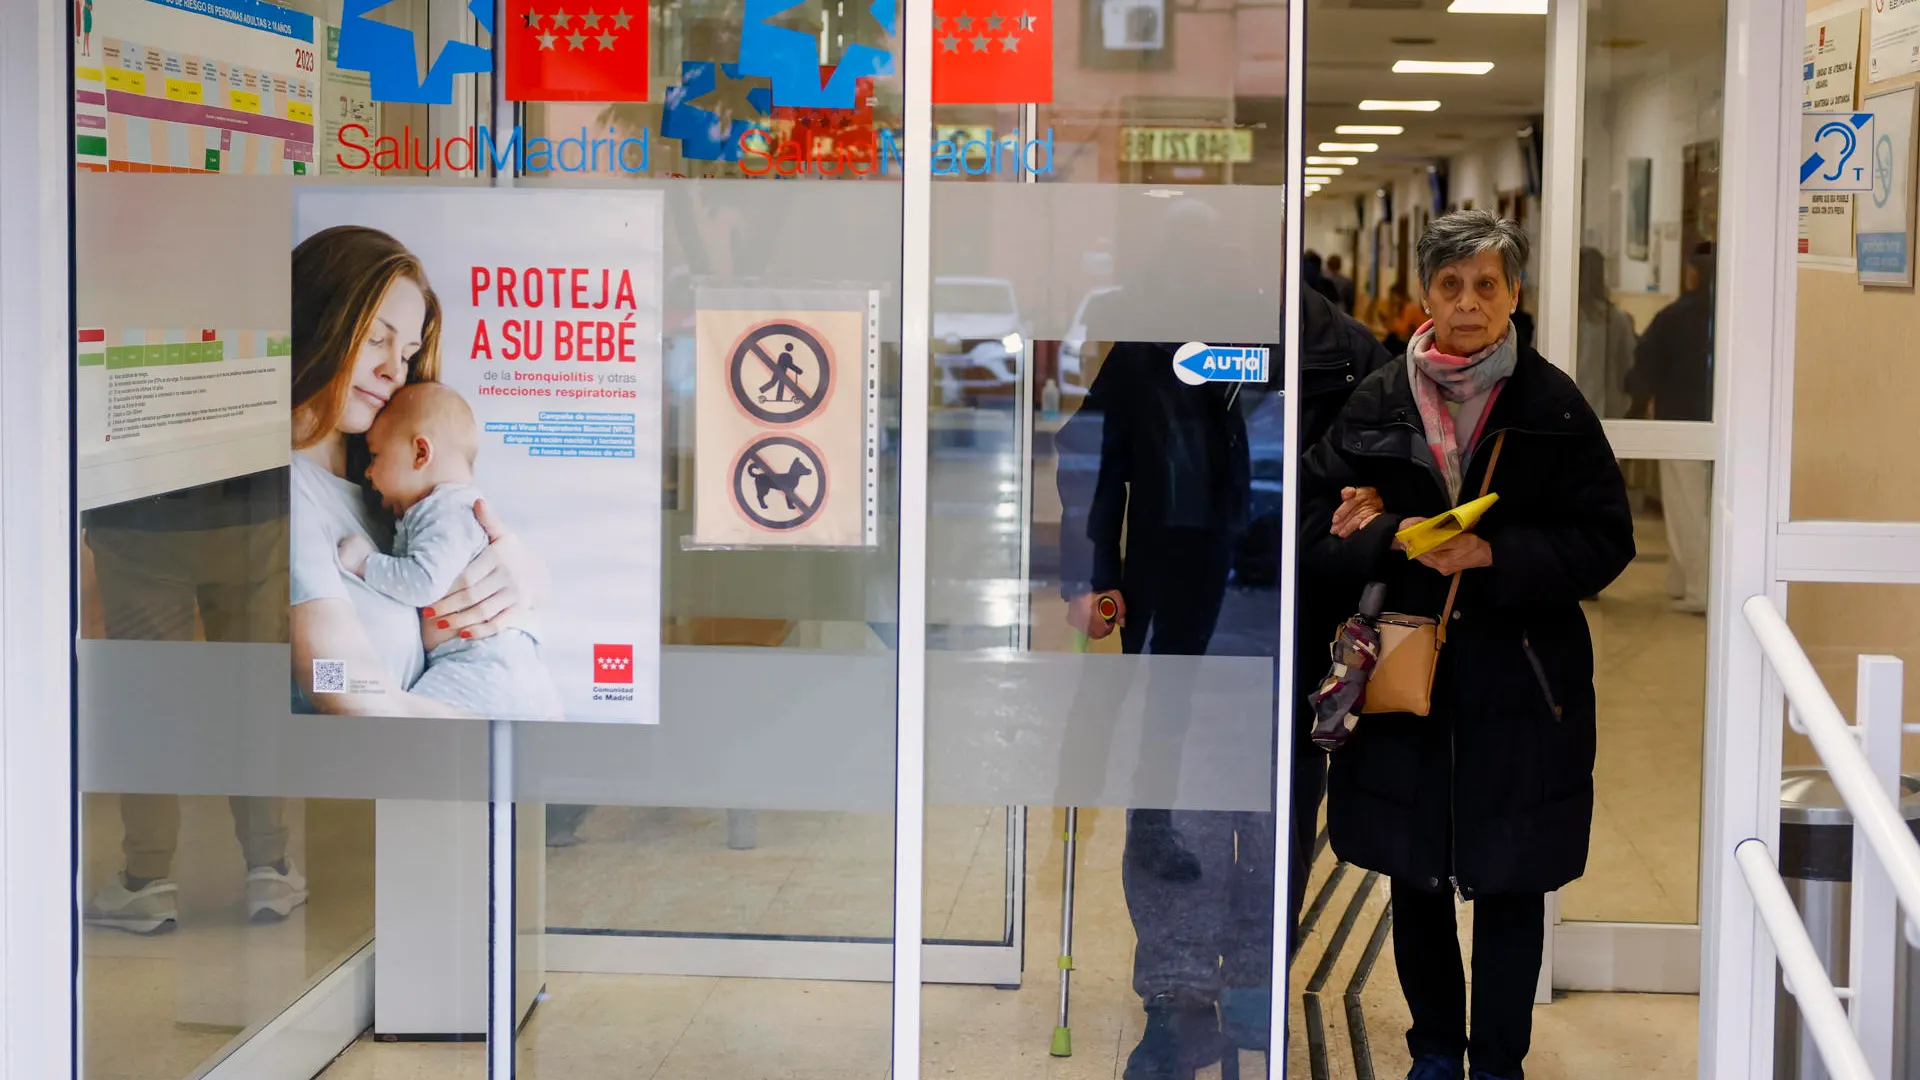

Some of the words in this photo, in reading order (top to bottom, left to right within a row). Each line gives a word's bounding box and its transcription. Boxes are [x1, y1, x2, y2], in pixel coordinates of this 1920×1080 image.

[215, 5, 242, 22] PERSONAS
[244, 13, 267, 28] ADULTAS
[295, 48, 314, 72] 2023
[336, 123, 649, 173] SaludMadrid
[1853, 168, 1864, 181] T
[471, 266, 637, 310] PROTEJA
[470, 318, 492, 360] A
[501, 319, 543, 361] SU
[554, 312, 637, 363] BEBÉ
[1202, 356, 1260, 370] AUTO
[484, 370, 498, 381] de
[501, 370, 511, 381] la
[514, 371, 594, 384] bronquiolitis
[598, 374, 604, 384] y
[607, 373, 637, 384] otras
[478, 385, 552, 397] infecciones
[555, 387, 637, 400] respiratorias
[486, 423, 510, 431] contra
[510, 423, 518, 431] el
[518, 424, 538, 432] Virus
